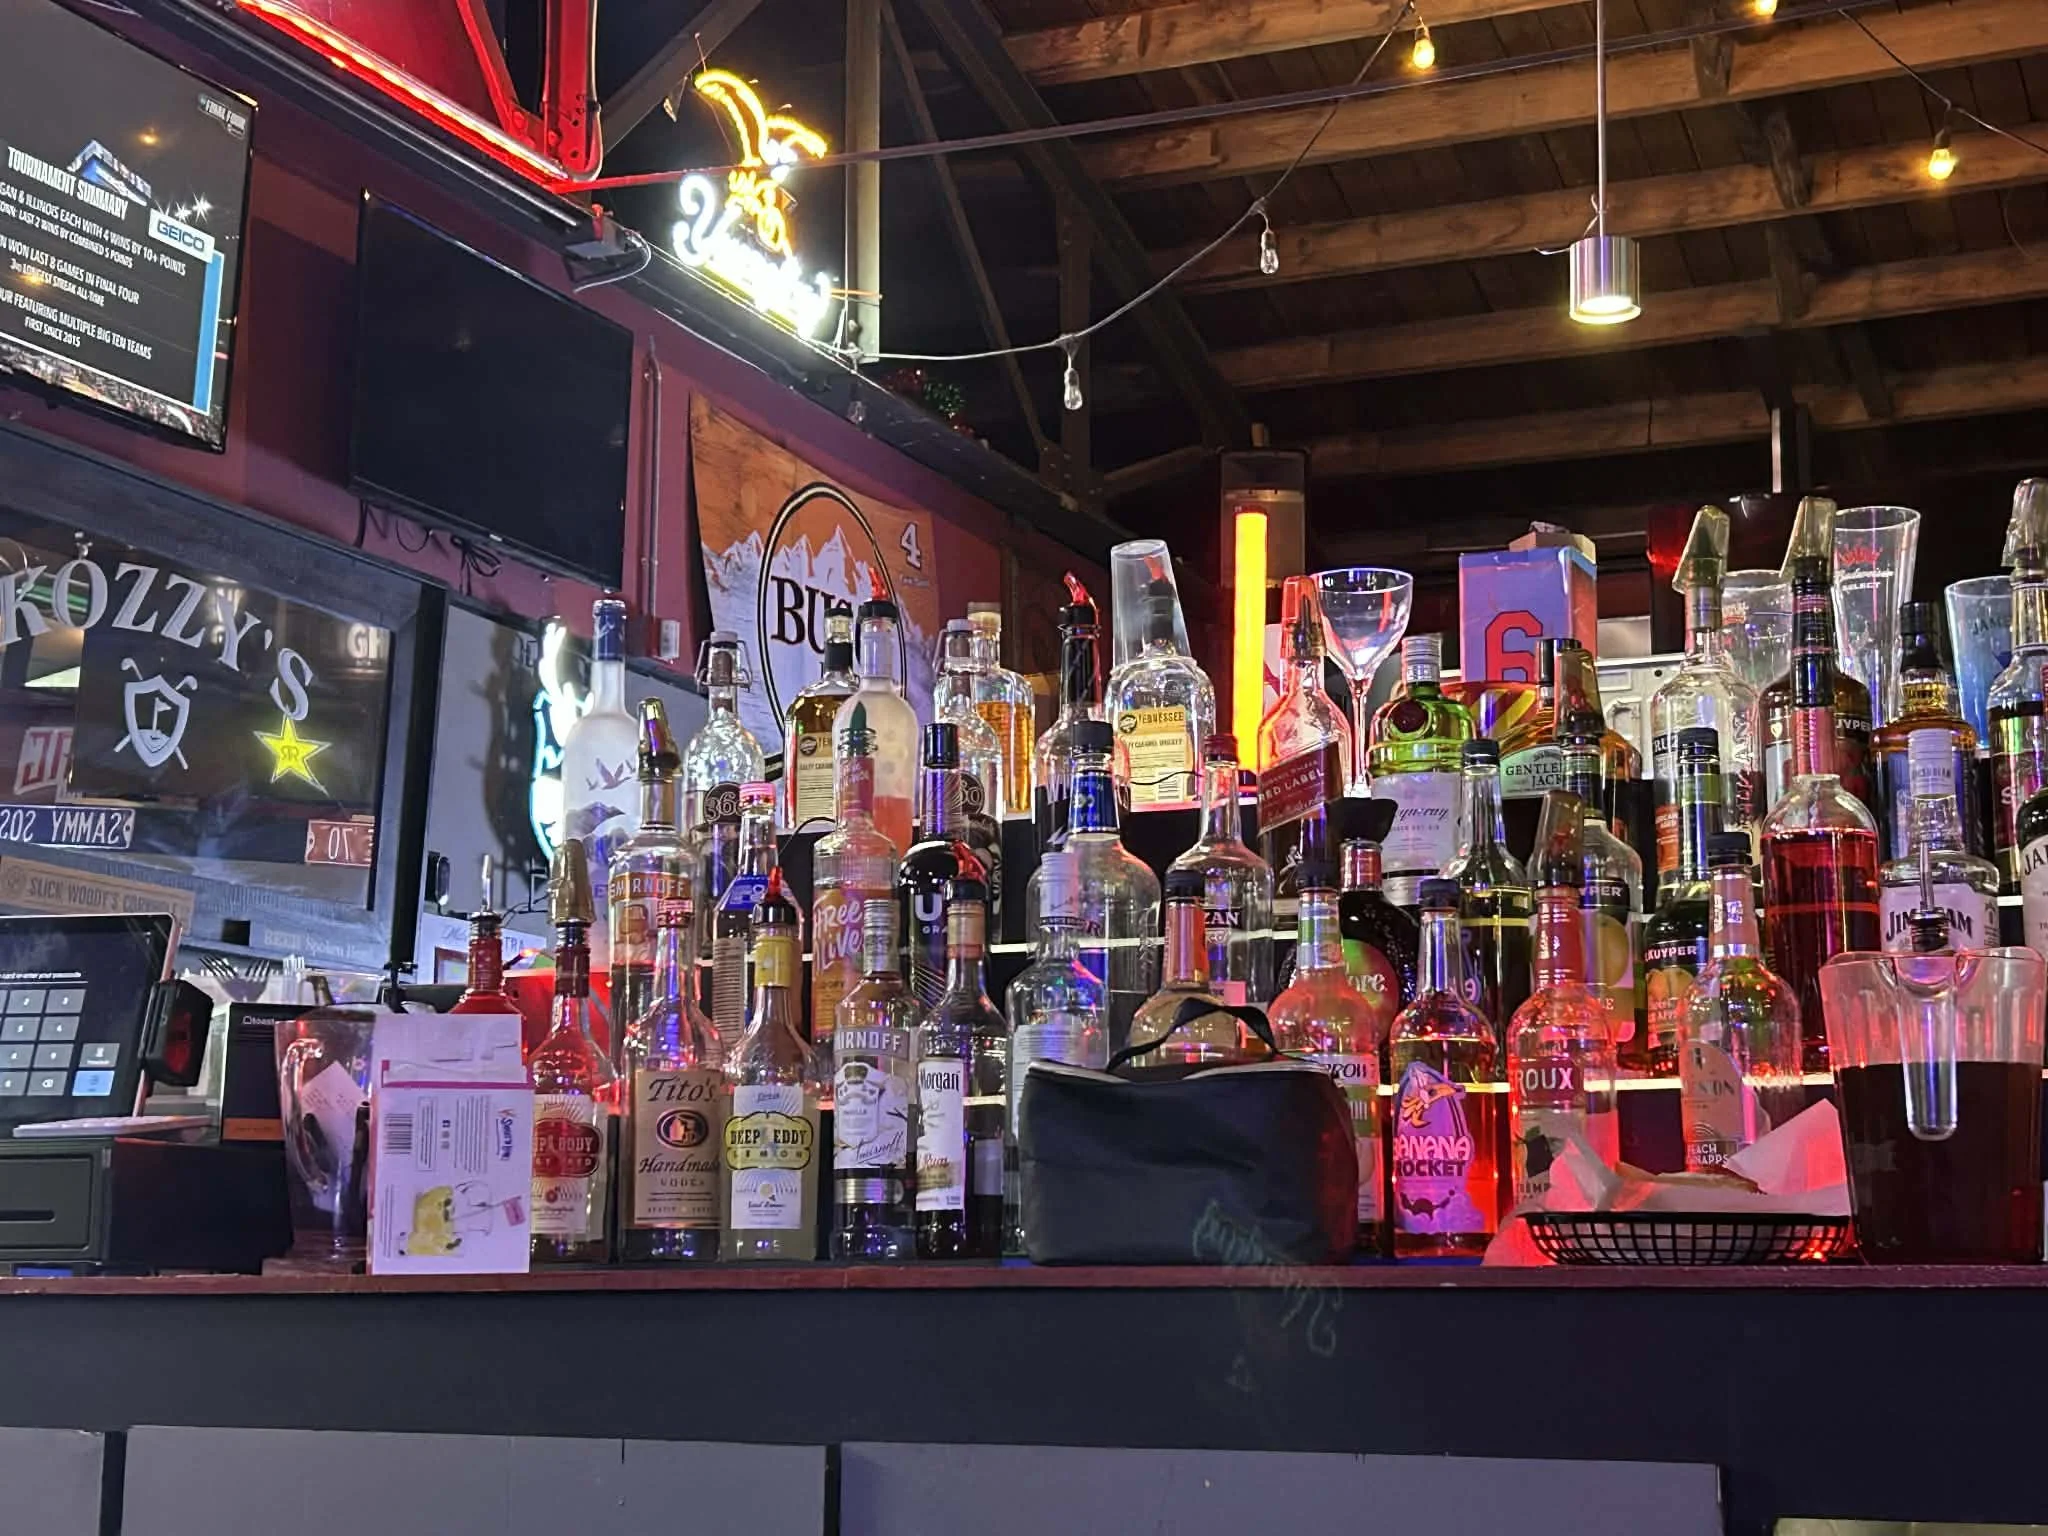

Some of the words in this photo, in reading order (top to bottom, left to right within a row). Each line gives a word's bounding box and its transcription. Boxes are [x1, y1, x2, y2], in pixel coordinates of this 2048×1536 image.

[205, 99, 226, 121] FINAL
[7, 146, 77, 197] TOURNAMENT
[76, 179, 128, 221] SUMMARY
[25, 193, 60, 220] ILLINOIS
[60, 208, 82, 229] EACH
[82, 218, 104, 239] WITH
[102, 229, 111, 242] 4
[131, 241, 143, 256] BY
[143, 245, 158, 263] 10+
[159, 253, 187, 277] POINTS
[156, 219, 206, 253] GEICO
[7, 238, 30, 260] WON
[29, 247, 50, 266] LAST
[56, 259, 85, 282] GAMES
[84, 271, 95, 287] IN
[94, 274, 118, 297] FINAL
[117, 285, 140, 305] FOUR
[13, 293, 59, 322] FEATURING
[58, 311, 97, 339] MULTIPLE
[96, 326, 112, 345] BIG
[111, 332, 127, 351] TEN
[126, 338, 153, 361] TEAMS
[24, 316, 43, 333] FIRST
[62, 330, 81, 348] 2015
[899, 521, 921, 570] 4
[1841, 581, 1881, 591] SELECT
[0, 558, 314, 721] KOZZY'S
[1283, 768, 1325, 792] LABEL
[1505, 761, 1562, 776] GENTLE
[648, 1074, 717, 1103] Tito's
[730, 1129, 761, 1145] DEEP
[773, 1128, 808, 1145] EDDY
